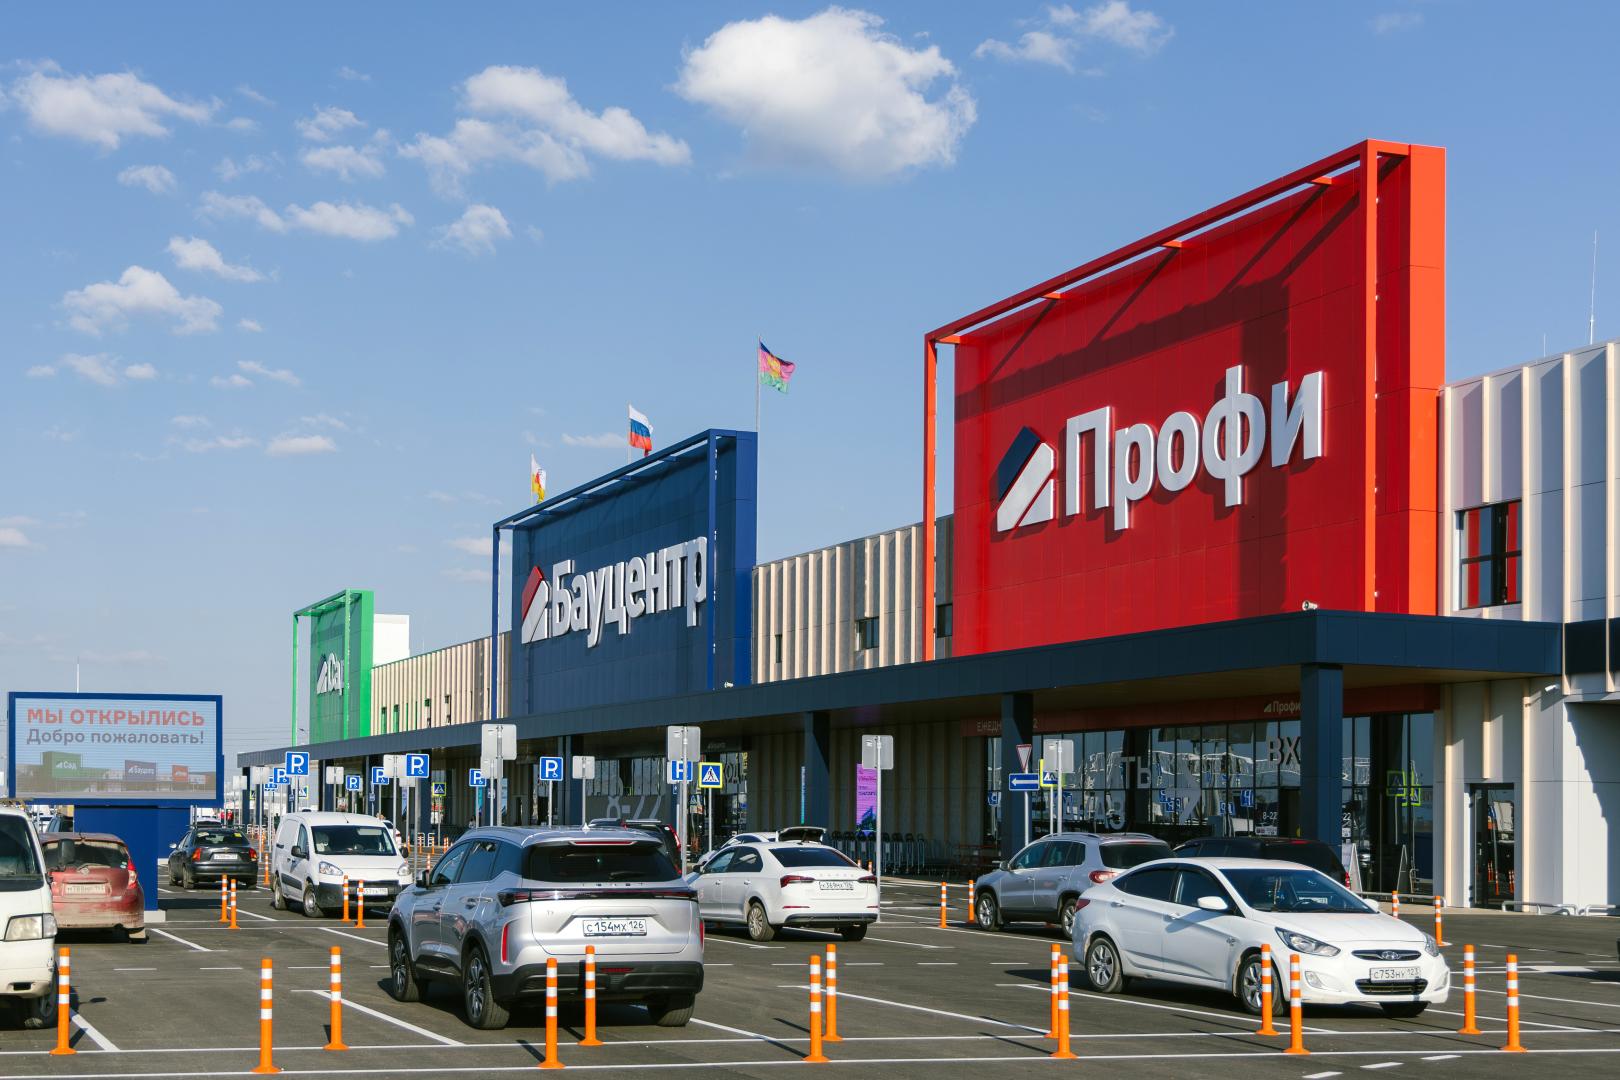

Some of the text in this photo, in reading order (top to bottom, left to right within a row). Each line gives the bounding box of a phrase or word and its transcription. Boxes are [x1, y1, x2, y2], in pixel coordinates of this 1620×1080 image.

[1065, 363, 1325, 531] Профи
[552, 536, 708, 648] Бауцентр
[27, 708, 205, 726] МЫ ОТКРЫЛИСЬ
[26, 728, 205, 746] Добро пожаловать!
[628, 920, 644, 929] 126
